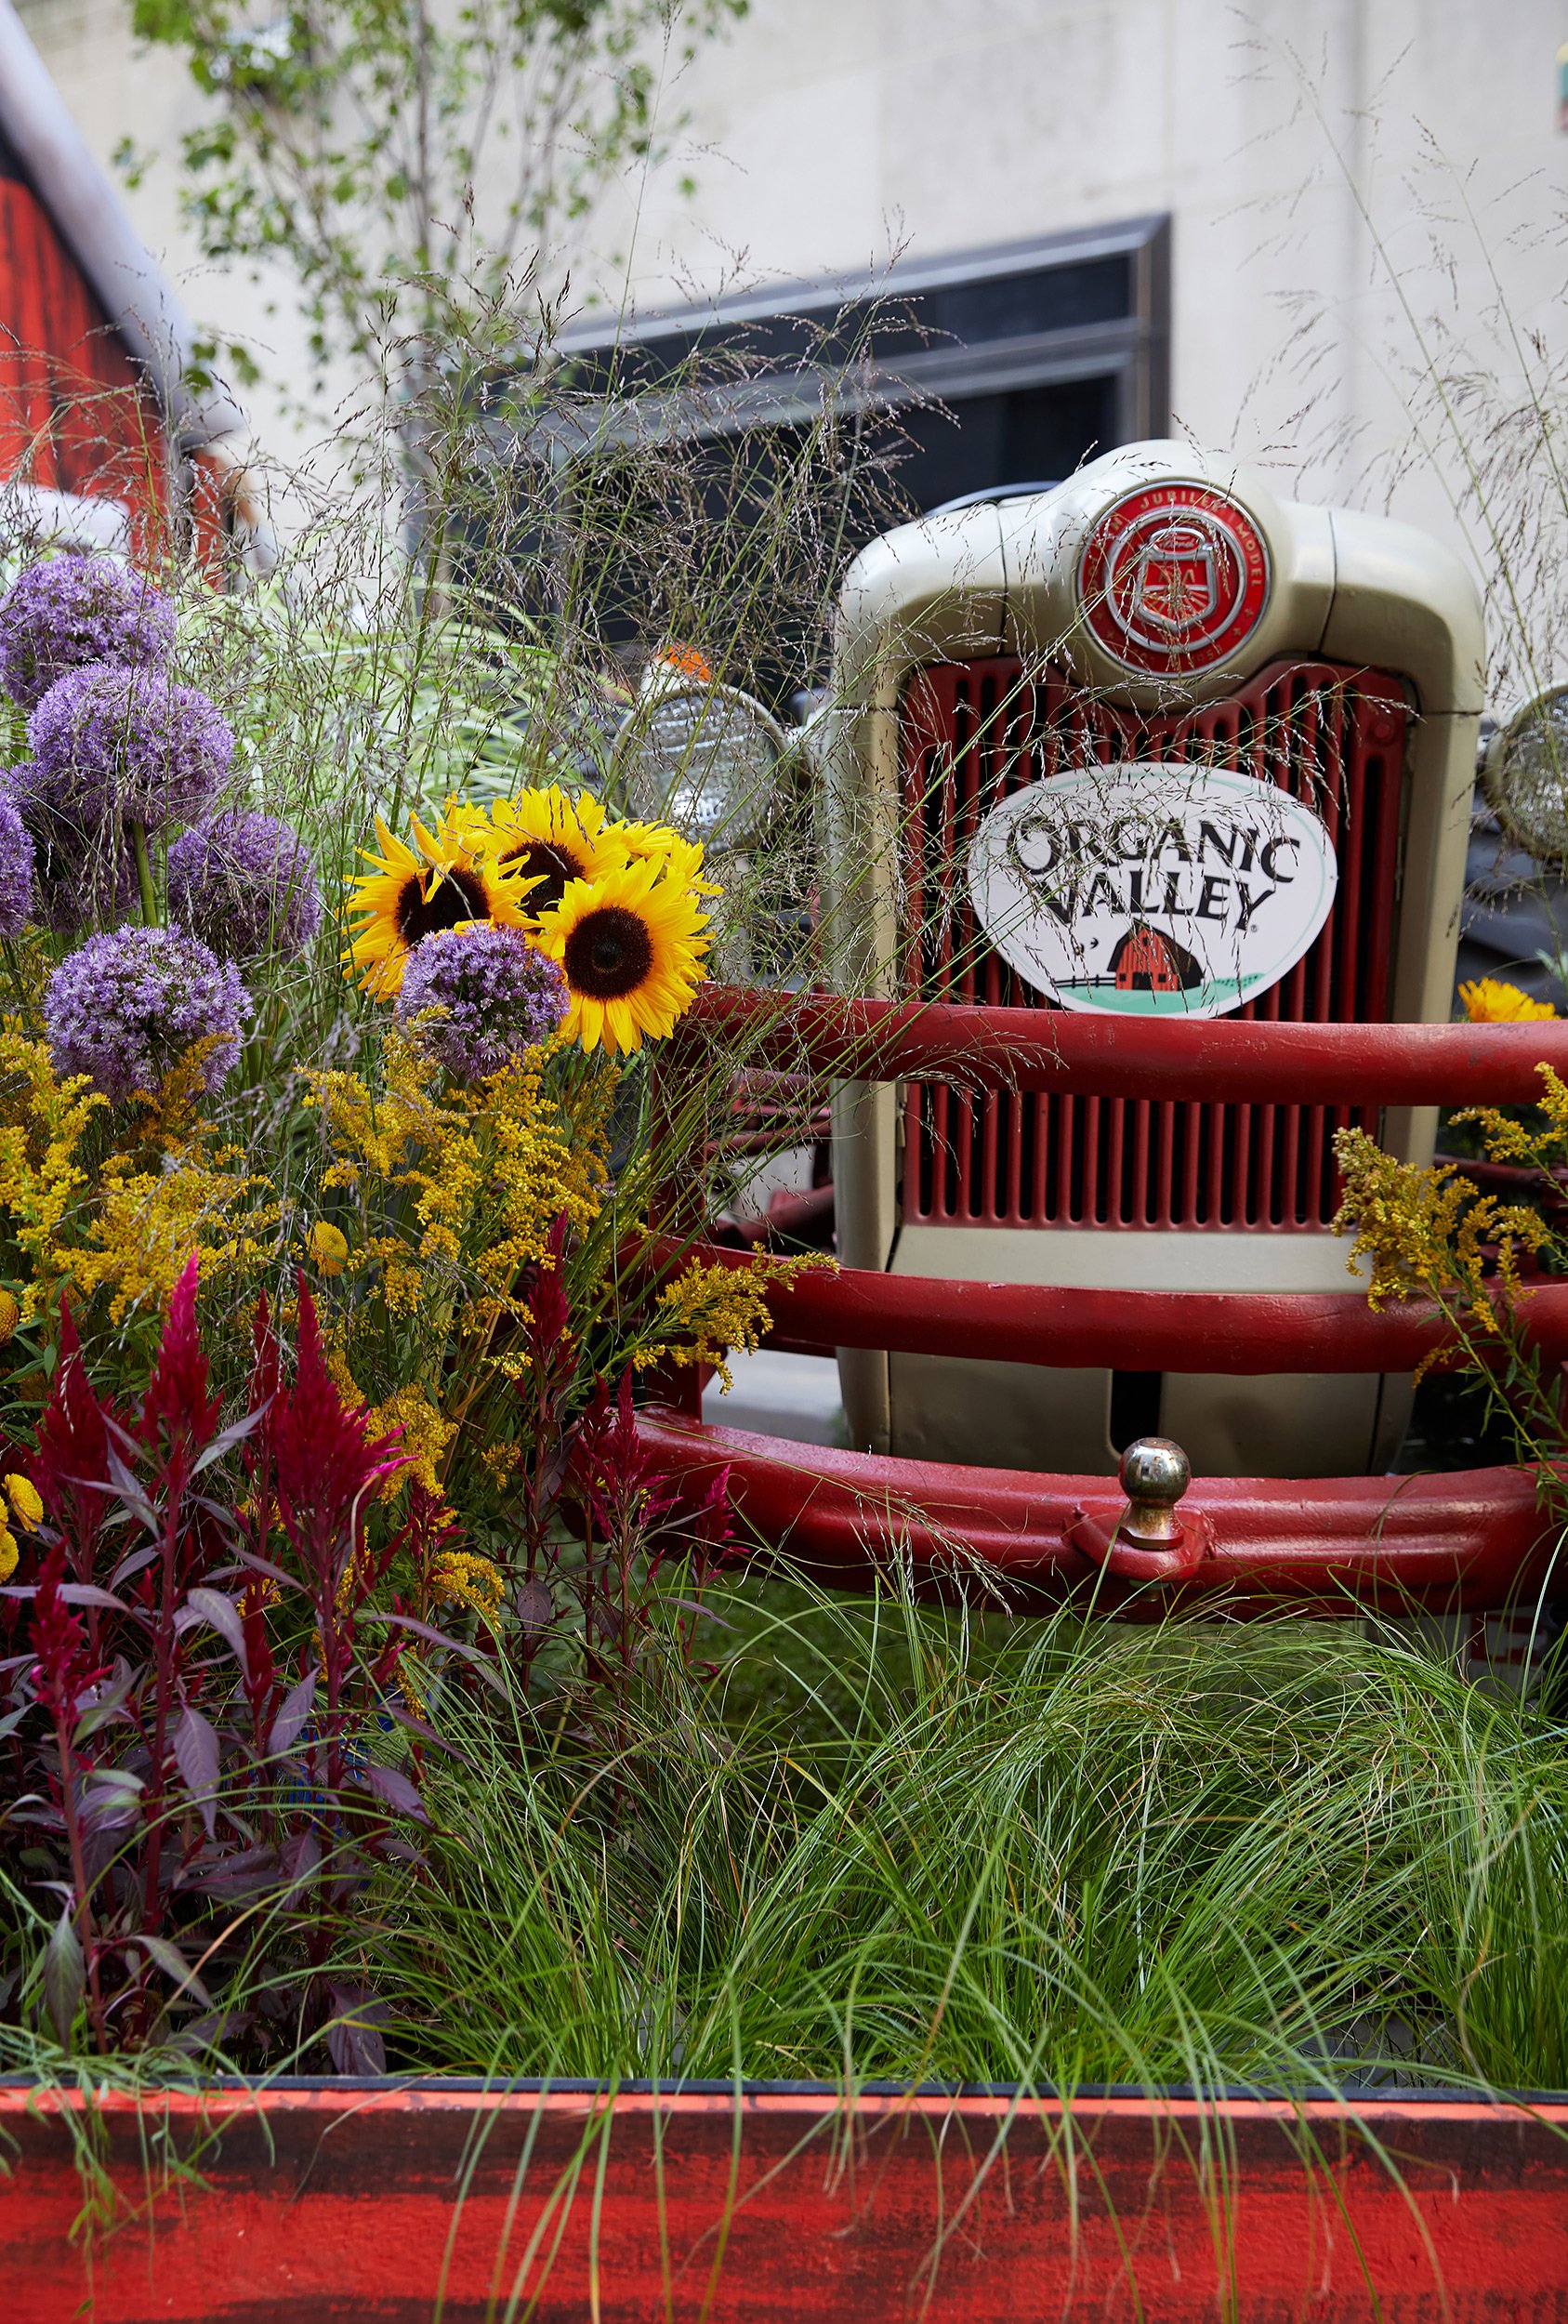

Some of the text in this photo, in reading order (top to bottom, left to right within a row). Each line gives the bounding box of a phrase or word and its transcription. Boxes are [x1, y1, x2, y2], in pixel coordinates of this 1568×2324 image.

[1235, 522, 1262, 588] MODEL
[1006, 815, 1301, 883] ORGANIC
[1032, 870, 1275, 931] VALLEY
